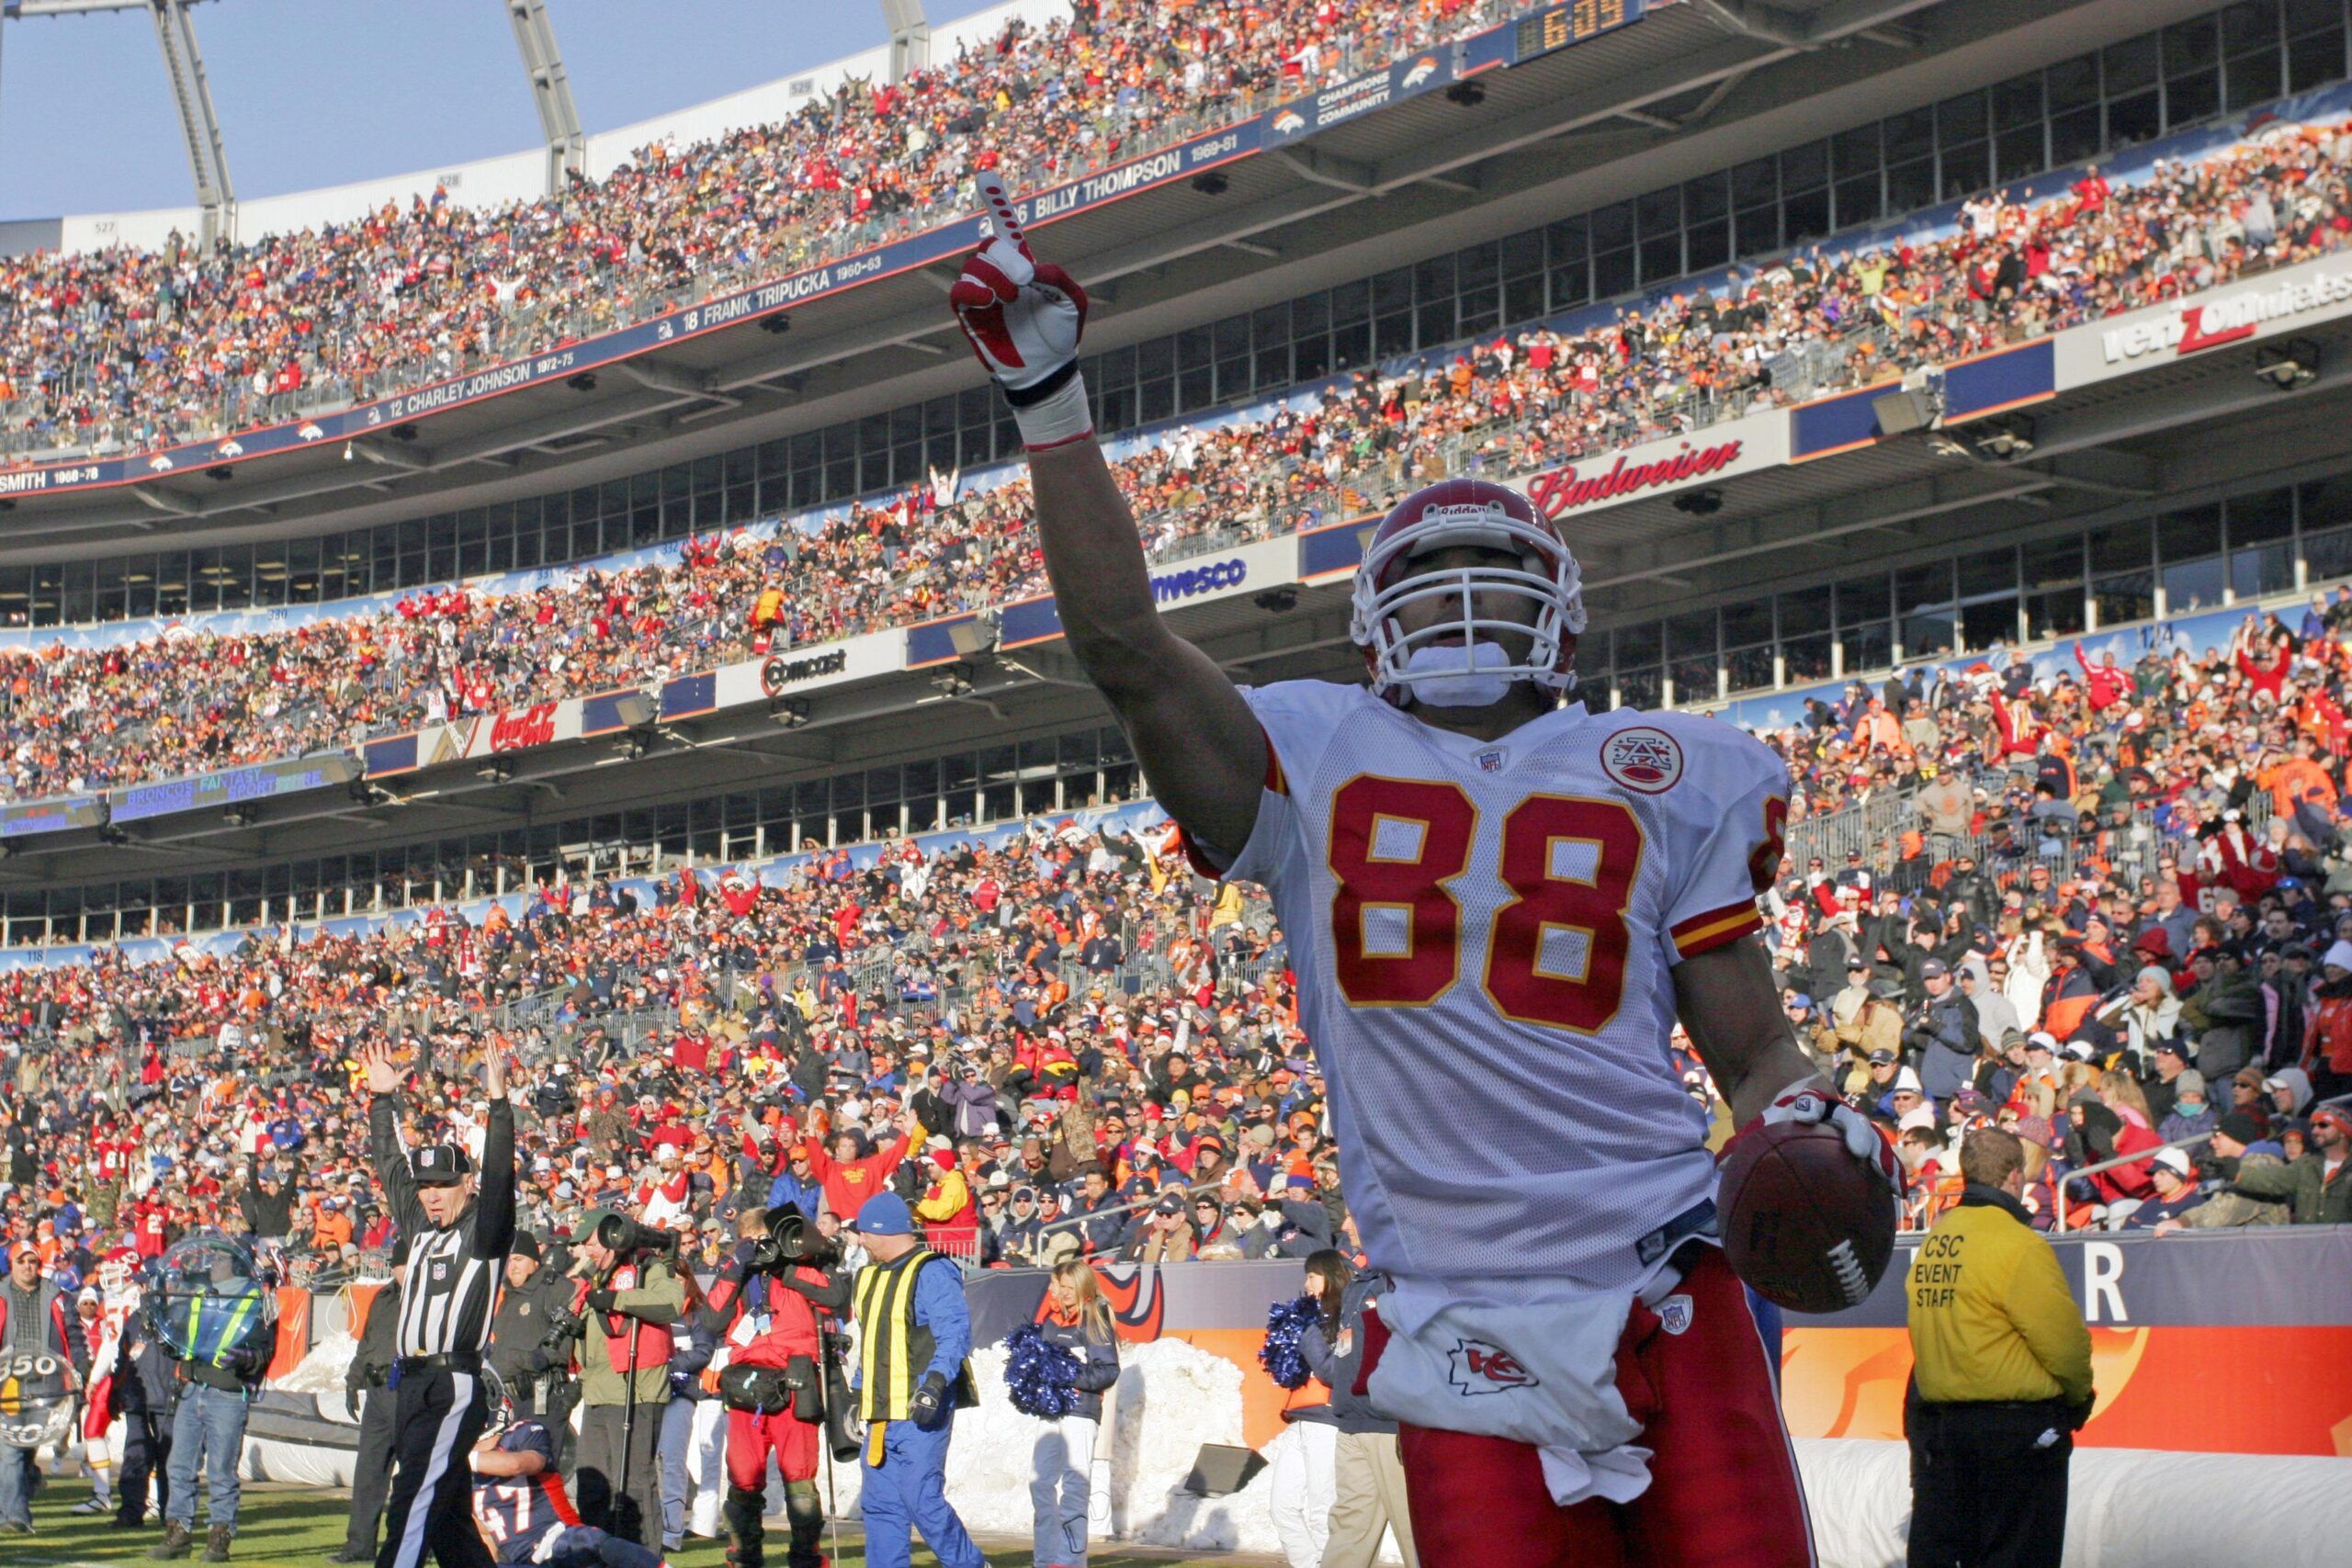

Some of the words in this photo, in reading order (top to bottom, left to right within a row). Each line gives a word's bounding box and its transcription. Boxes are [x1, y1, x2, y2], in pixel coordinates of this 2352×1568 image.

[1317, 71, 1390, 107] CHAMPIONS
[1317, 89, 1390, 126] COMMUNITY
[1035, 186, 1080, 219] BILLY
[1082, 151, 1182, 203] THOMPSON
[683, 311, 698, 332] 18
[704, 294, 752, 326] FRANK
[756, 269, 831, 308] TRIPUCKA
[2102, 291, 2260, 365] verizon
[390, 400, 403, 419] 12
[407, 380, 466, 413] CHARLEY
[467, 363, 531, 396] JOHNSON
[537, 353, 574, 374] 1972-75
[0, 470, 46, 493] SMITH
[1527, 440, 1743, 520] Budweiser
[128, 782, 193, 805] BRONCOS
[199, 768, 263, 792] FANTASY
[1326, 773, 1645, 1035] 88
[28, 951, 44, 963] 118
[1924, 1235, 1965, 1258] CSC
[1915, 1263, 1962, 1284] EVENT
[1917, 1288, 1956, 1308] STAFF
[472, 1485, 531, 1543] 47
